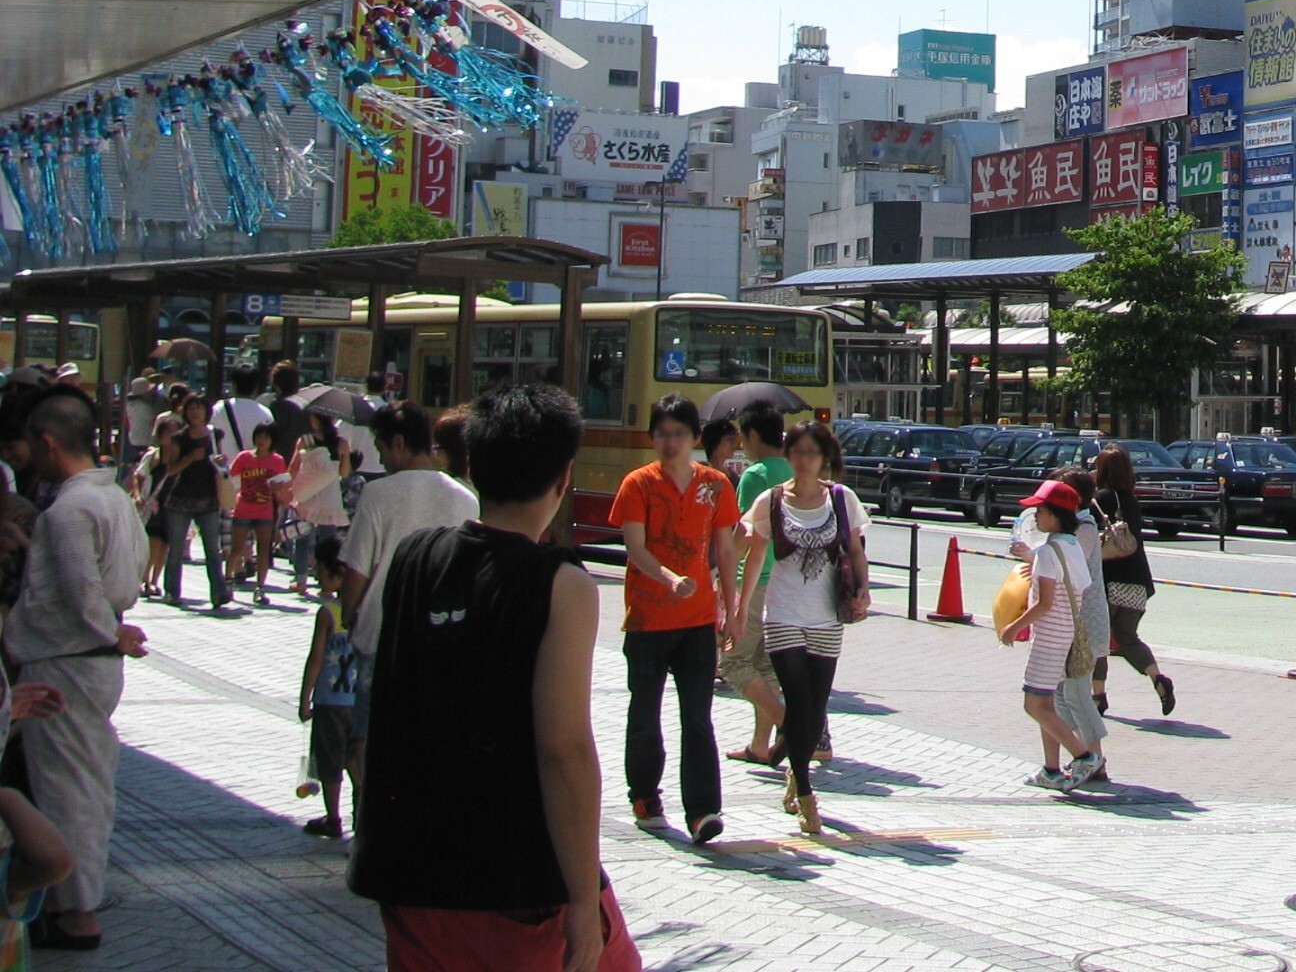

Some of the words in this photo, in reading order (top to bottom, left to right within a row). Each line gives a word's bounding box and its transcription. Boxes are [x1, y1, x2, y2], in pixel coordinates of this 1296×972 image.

[1249, 26, 1296, 58] 住まいの
[928, 50, 992, 66] 平塚信用金庫
[1248, 51, 1296, 88] 情報館
[603, 140, 671, 164] さくら水産
[1027, 151, 1081, 203] 魚民
[1092, 140, 1142, 201] 魚民
[1144, 155, 1158, 185] 魚民
[1182, 161, 1213, 188] レイク
[655, 184, 677, 197] PICE
[246, 294, 263, 313] 8
